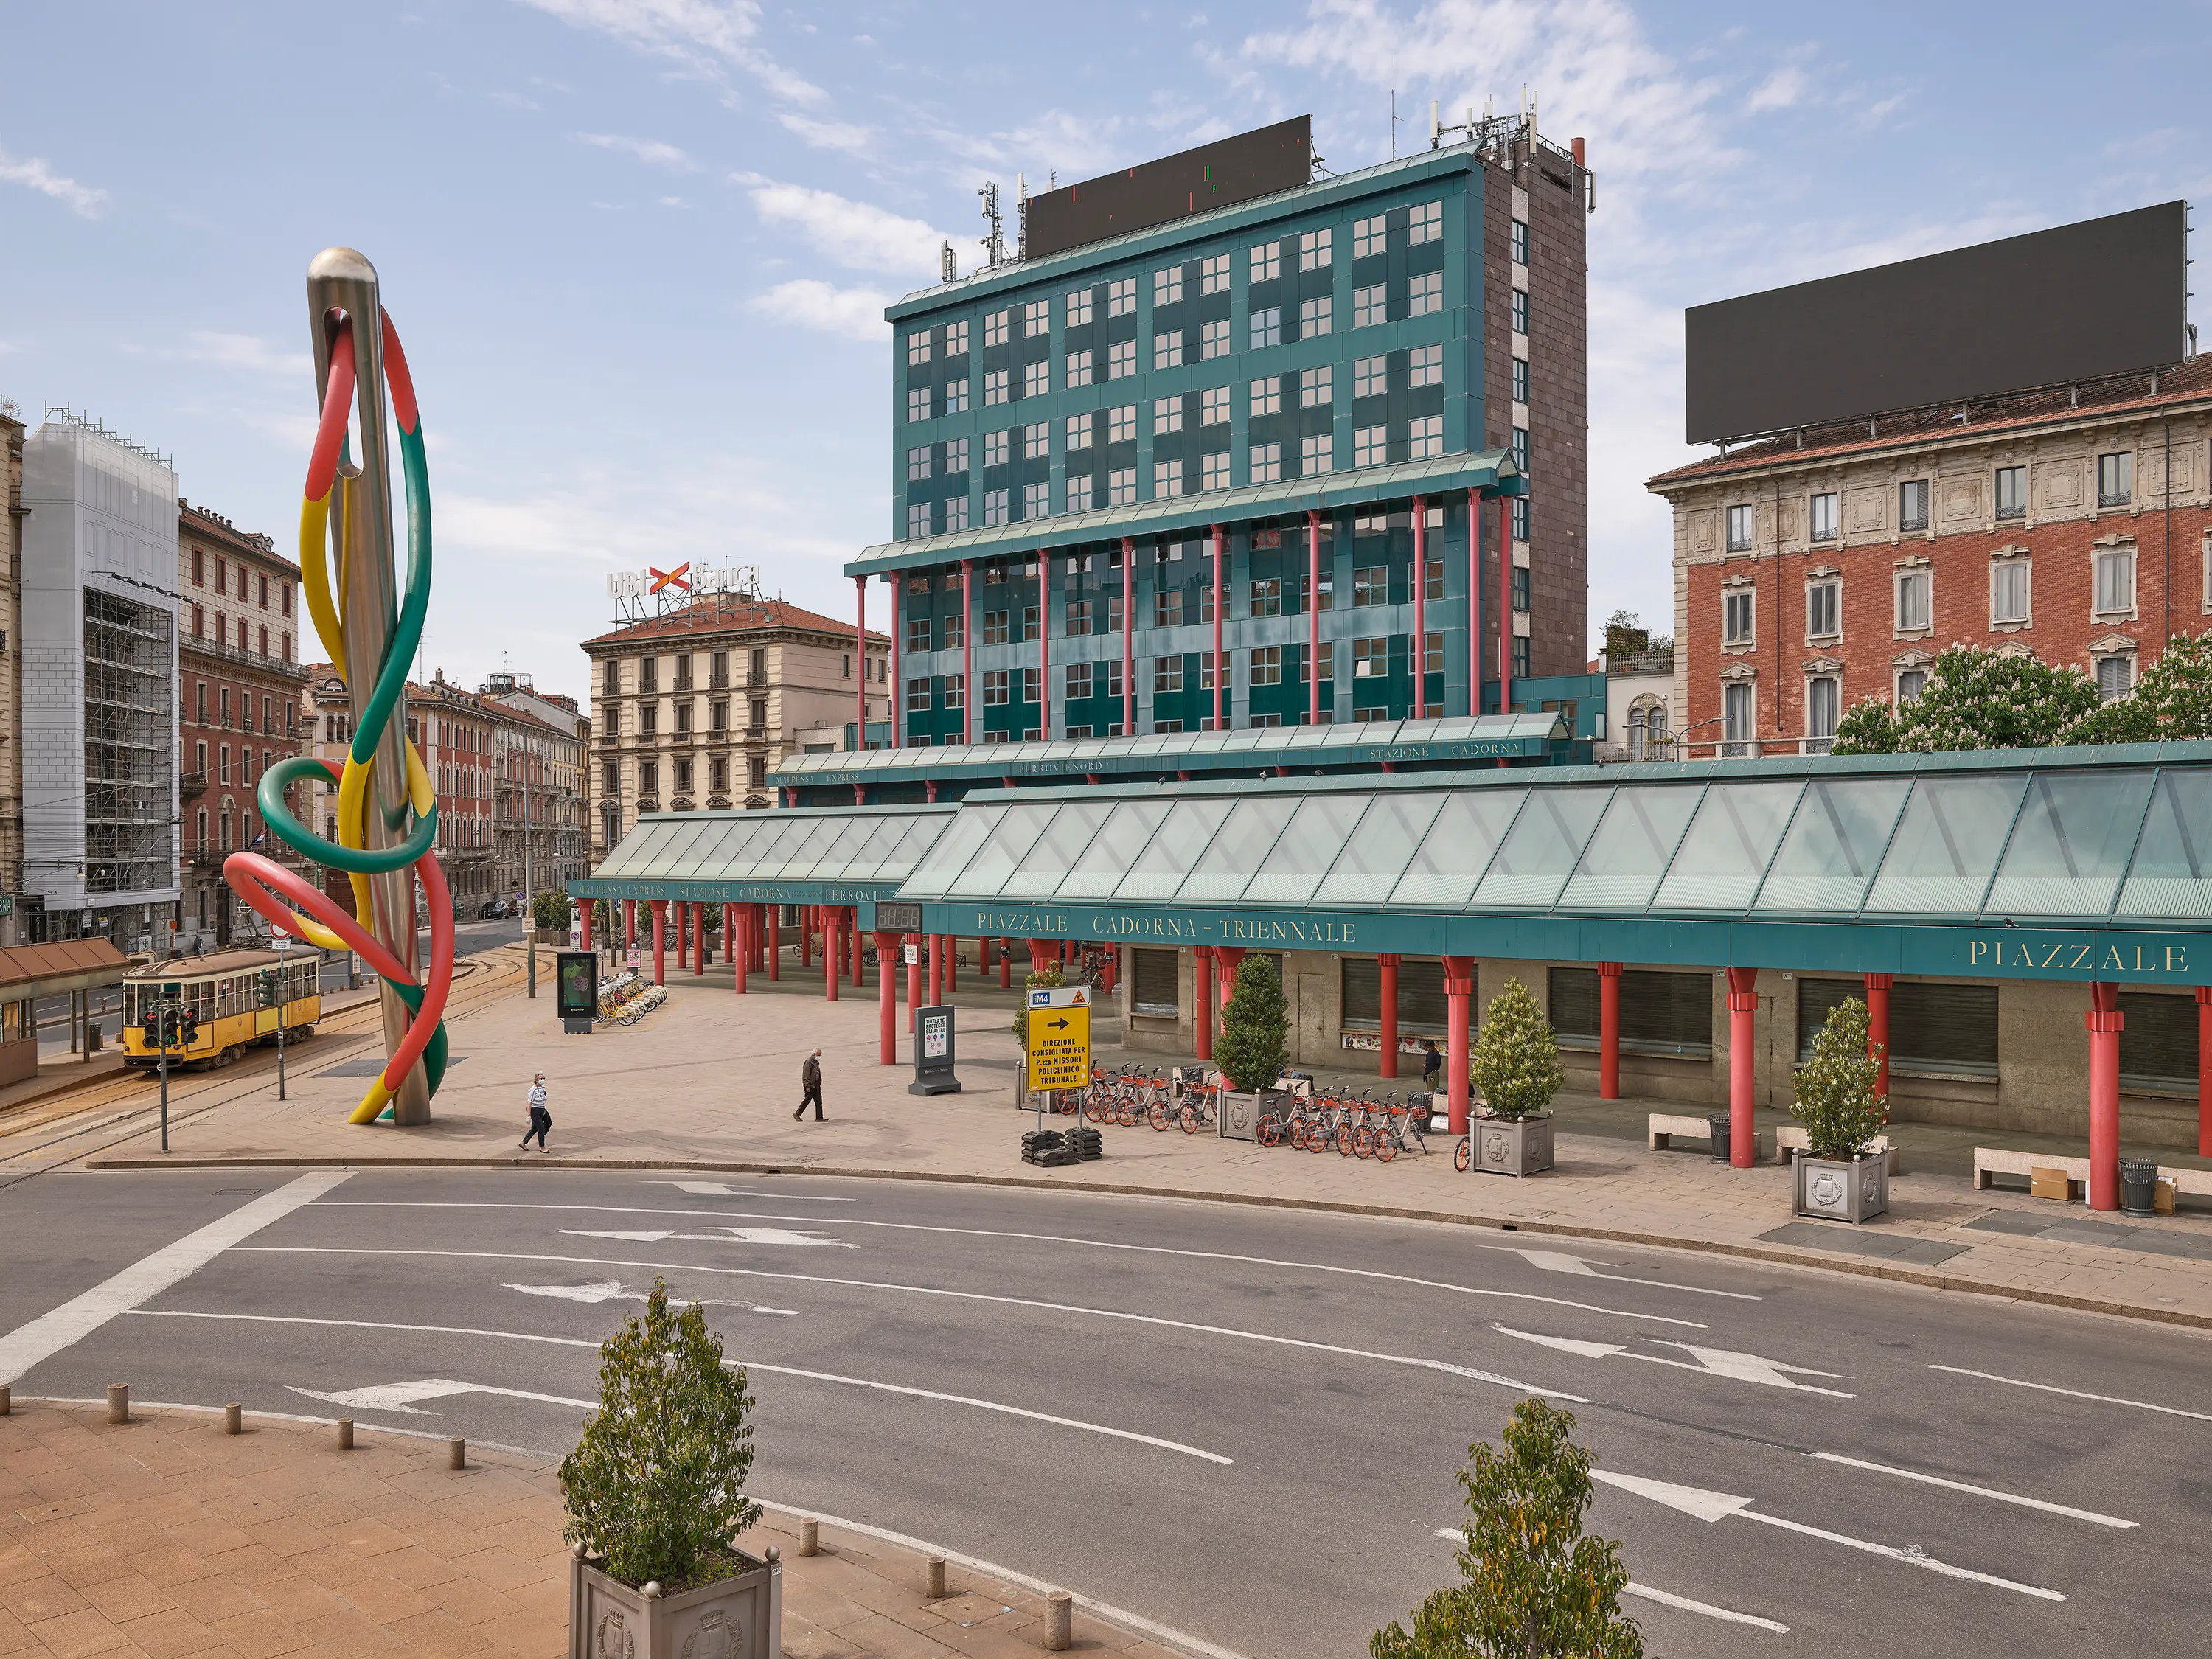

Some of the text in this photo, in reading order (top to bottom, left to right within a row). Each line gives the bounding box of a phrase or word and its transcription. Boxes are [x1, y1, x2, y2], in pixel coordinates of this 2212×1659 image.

[607, 564, 760, 599] UBI Banca
[1370, 743, 1519, 759] STAZIONE CADORNA
[776, 773, 859, 784] MALPENSA EXPRESS
[578, 884, 622, 895] MALPENSA
[627, 885, 666, 897] EXPRESS
[679, 886, 728, 898] STAZIONE
[740, 887, 790, 900] CADORNA
[977, 912, 1068, 931] PIAZZALE
[1093, 916, 1197, 937] CADORNA
[1219, 919, 1357, 942] TRIENNALE
[1968, 940, 2189, 972] PIAZZALE
[1035, 995, 1048, 1004] M4
[1042, 1038, 1076, 1047] DIREZIONE
[1032, 1047, 1072, 1057] CONSIGLIATA
[1053, 1056, 1082, 1065] MISSORI
[1038, 1065, 1079, 1075] POLICLINICO
[1040, 1075, 1077, 1085] TRIBUNALE
